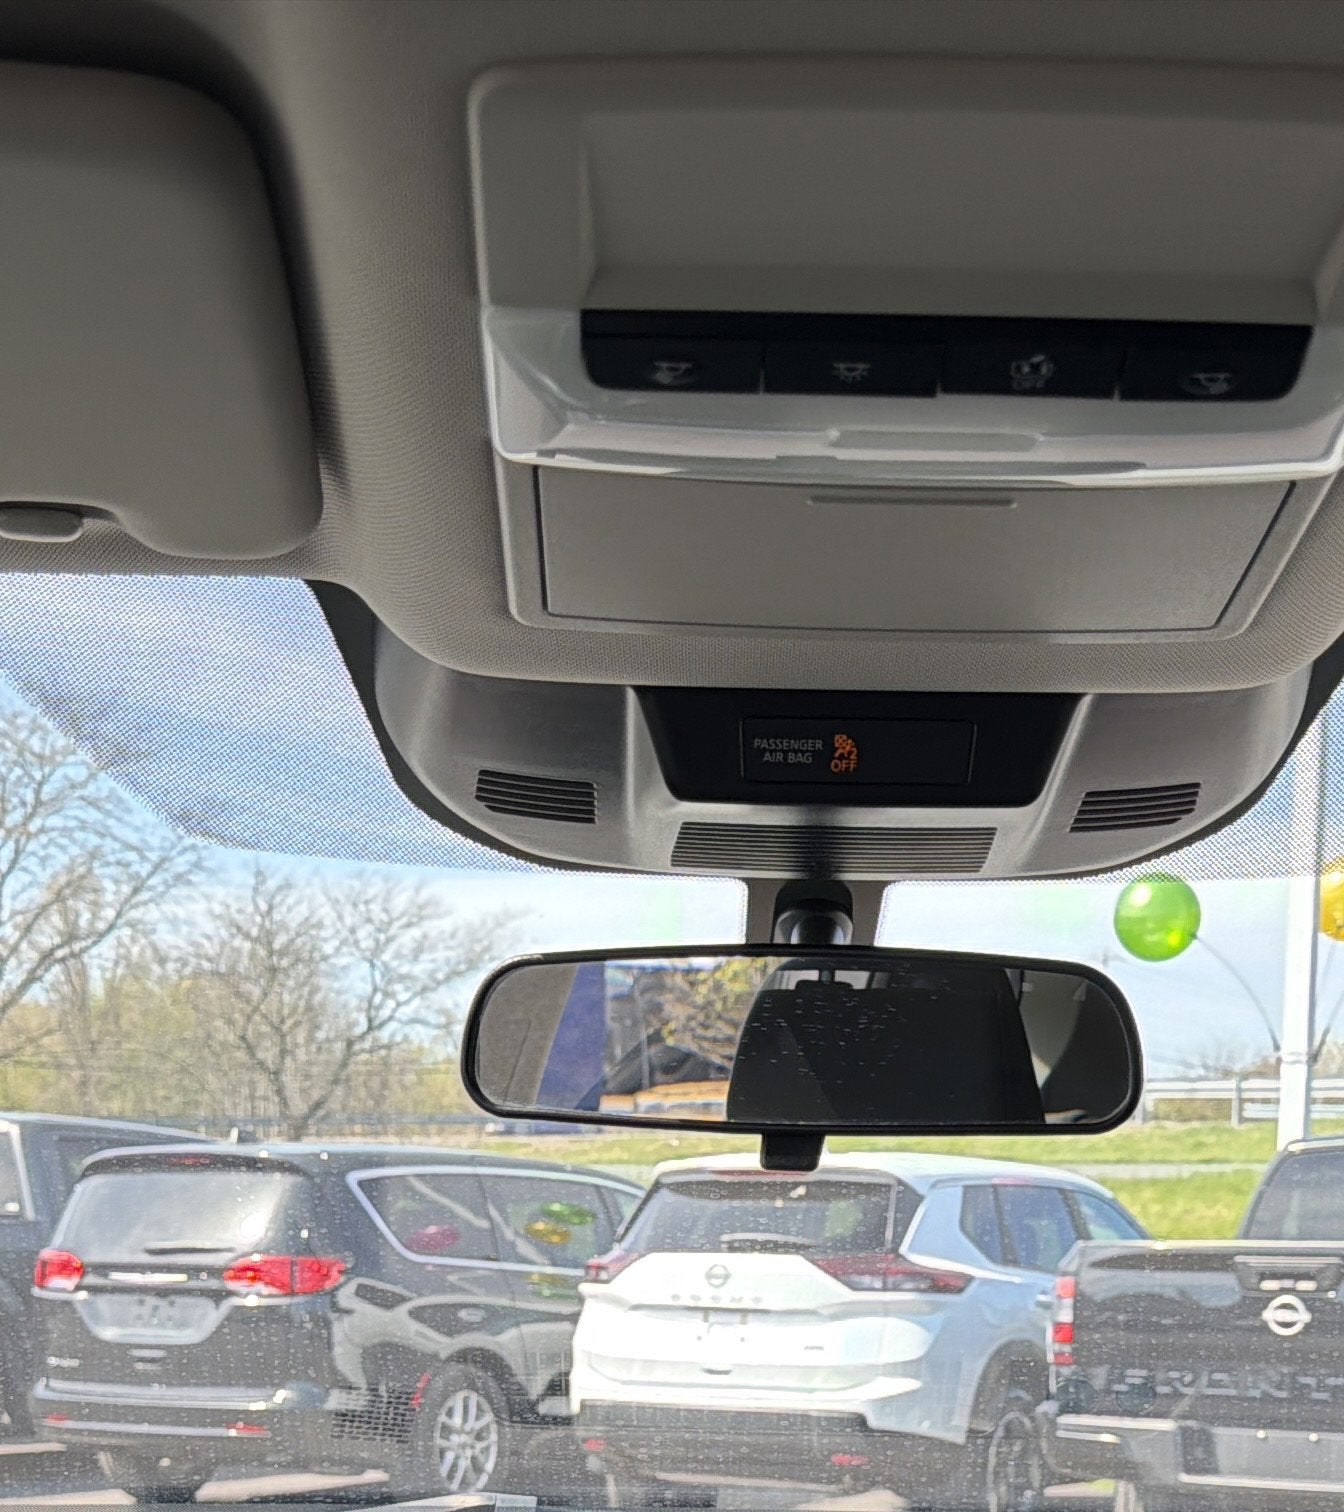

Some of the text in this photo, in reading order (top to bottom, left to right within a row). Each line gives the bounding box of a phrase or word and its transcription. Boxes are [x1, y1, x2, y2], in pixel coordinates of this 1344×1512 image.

[753, 738, 824, 751] PASSENGER
[762, 752, 813, 764] AIR BAG
[830, 759, 858, 773] OFF
